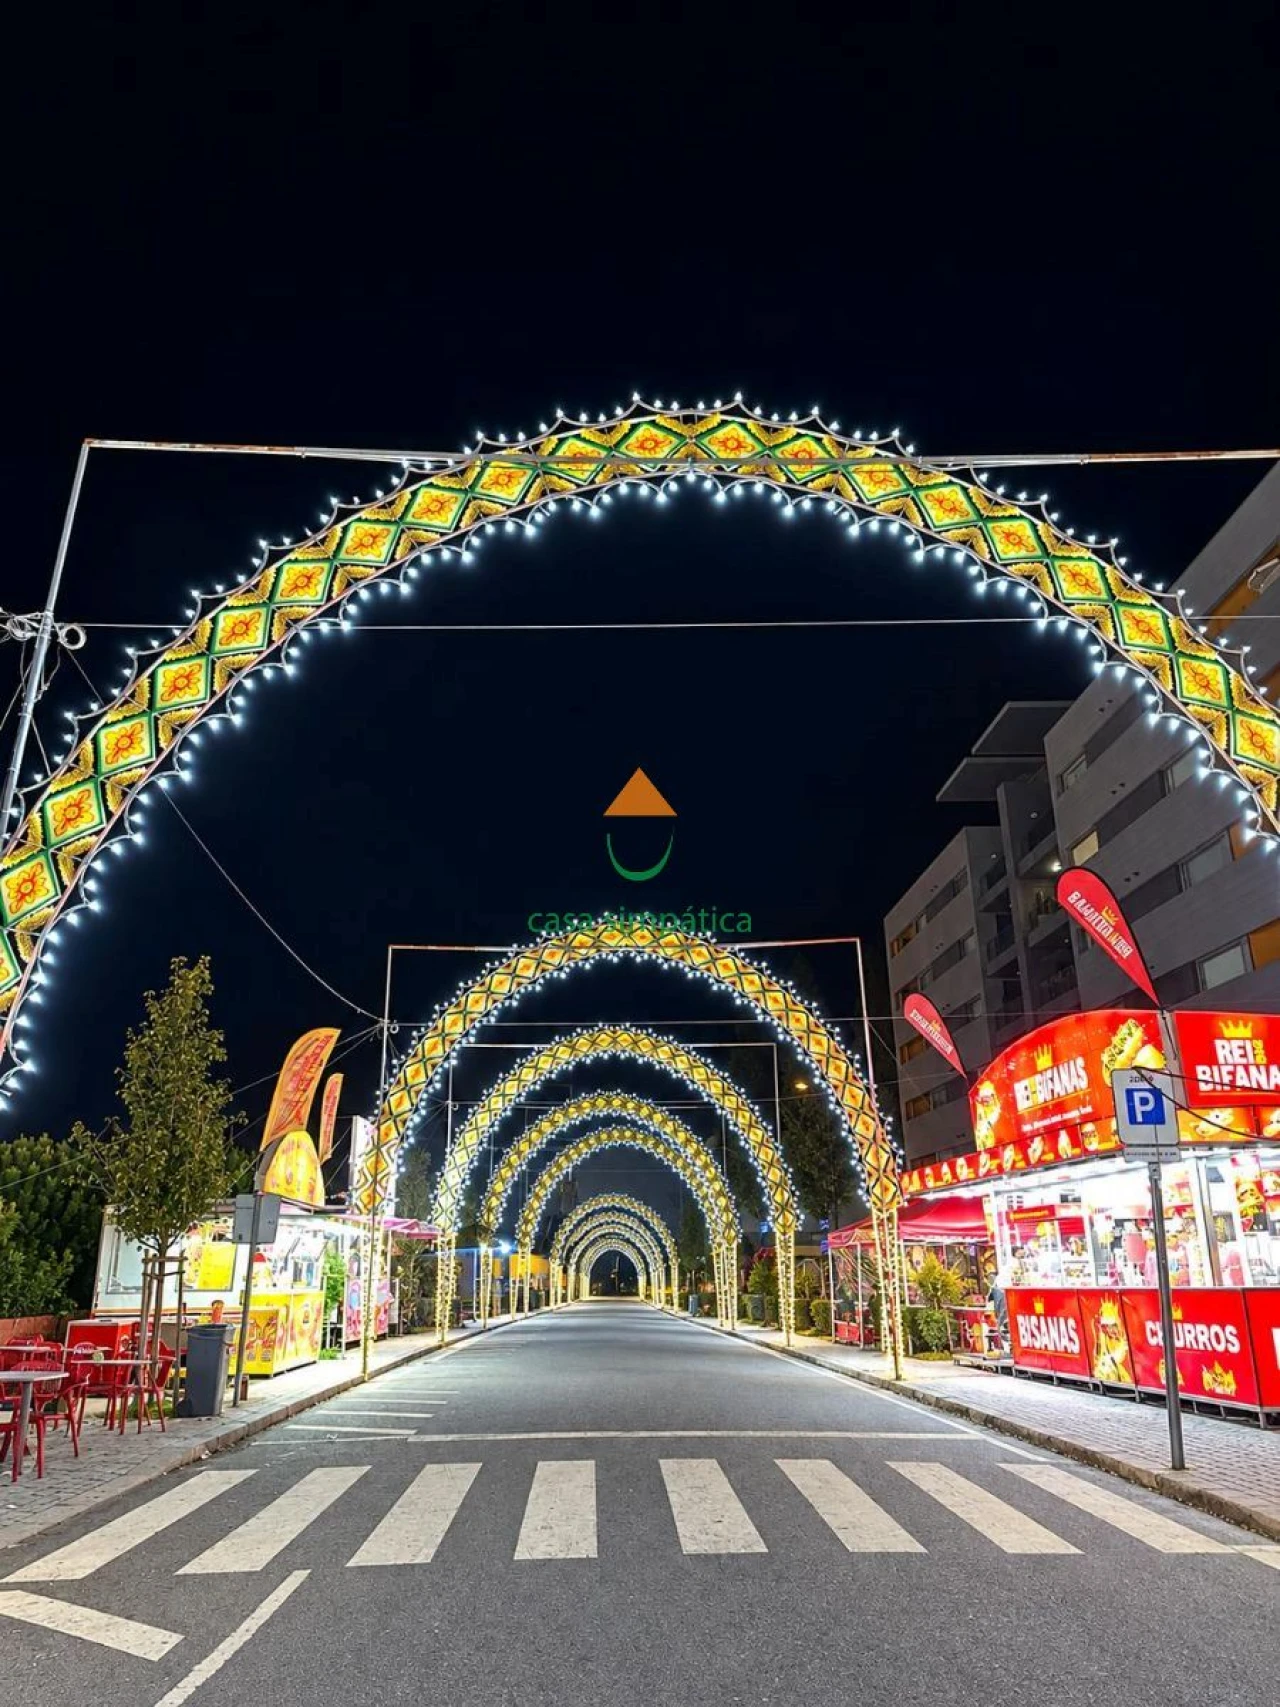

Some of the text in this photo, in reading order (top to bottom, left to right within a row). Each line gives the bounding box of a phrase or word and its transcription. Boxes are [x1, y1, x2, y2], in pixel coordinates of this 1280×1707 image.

[1215, 1039, 1255, 1065] REI
[1035, 1056, 1089, 1105] BIFANAS
[1133, 1091, 1155, 1122] P
[1017, 1315, 1080, 1354] BISANAS
